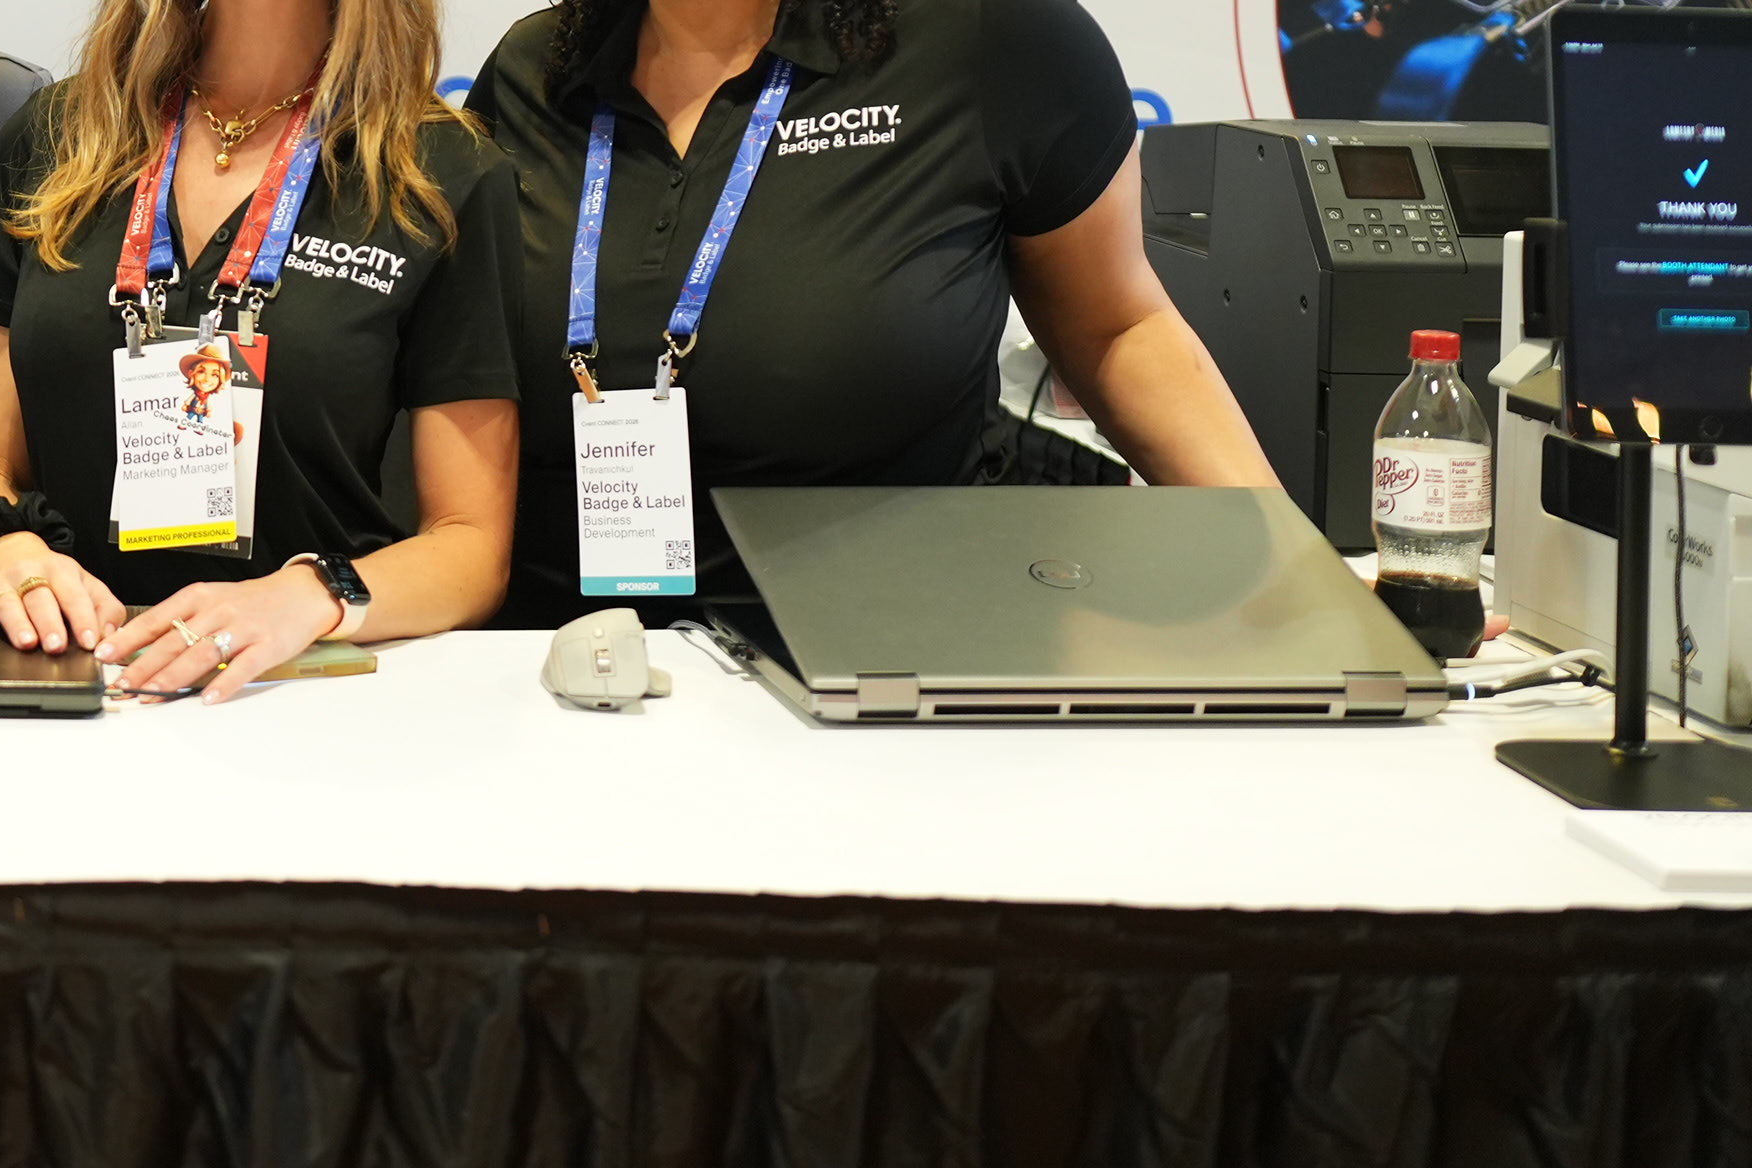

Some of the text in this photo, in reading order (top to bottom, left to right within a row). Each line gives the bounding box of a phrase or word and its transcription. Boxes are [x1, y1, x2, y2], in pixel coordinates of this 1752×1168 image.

[774, 79, 788, 95] One
[778, 128, 896, 156] Badge & Label
[591, 177, 604, 214] VELOCITY
[131, 193, 146, 235] VELOCITY
[270, 190, 292, 232] VELOCITY
[1659, 201, 1738, 219] THANK YOU
[689, 242, 713, 284] VELOCITY
[1662, 261, 1729, 272] BOOTH ATTENDANT
[284, 253, 395, 295] Badge & Label
[121, 396, 179, 413] Lamar
[153, 410, 233, 438] Chaos Coordinator
[122, 434, 180, 448] Velocity
[123, 443, 228, 465] Badge & Label
[580, 442, 655, 459] Jennifer
[123, 462, 229, 480] Marketing Manager
[1383, 456, 1399, 473] Dr
[582, 480, 638, 495] Velocity
[583, 495, 685, 512] Badge & Label
[584, 515, 631, 525] Business
[126, 529, 231, 544] MARKETING PROFESSIONAL
[584, 528, 656, 539] Development
[616, 582, 660, 591] SPONSOR
